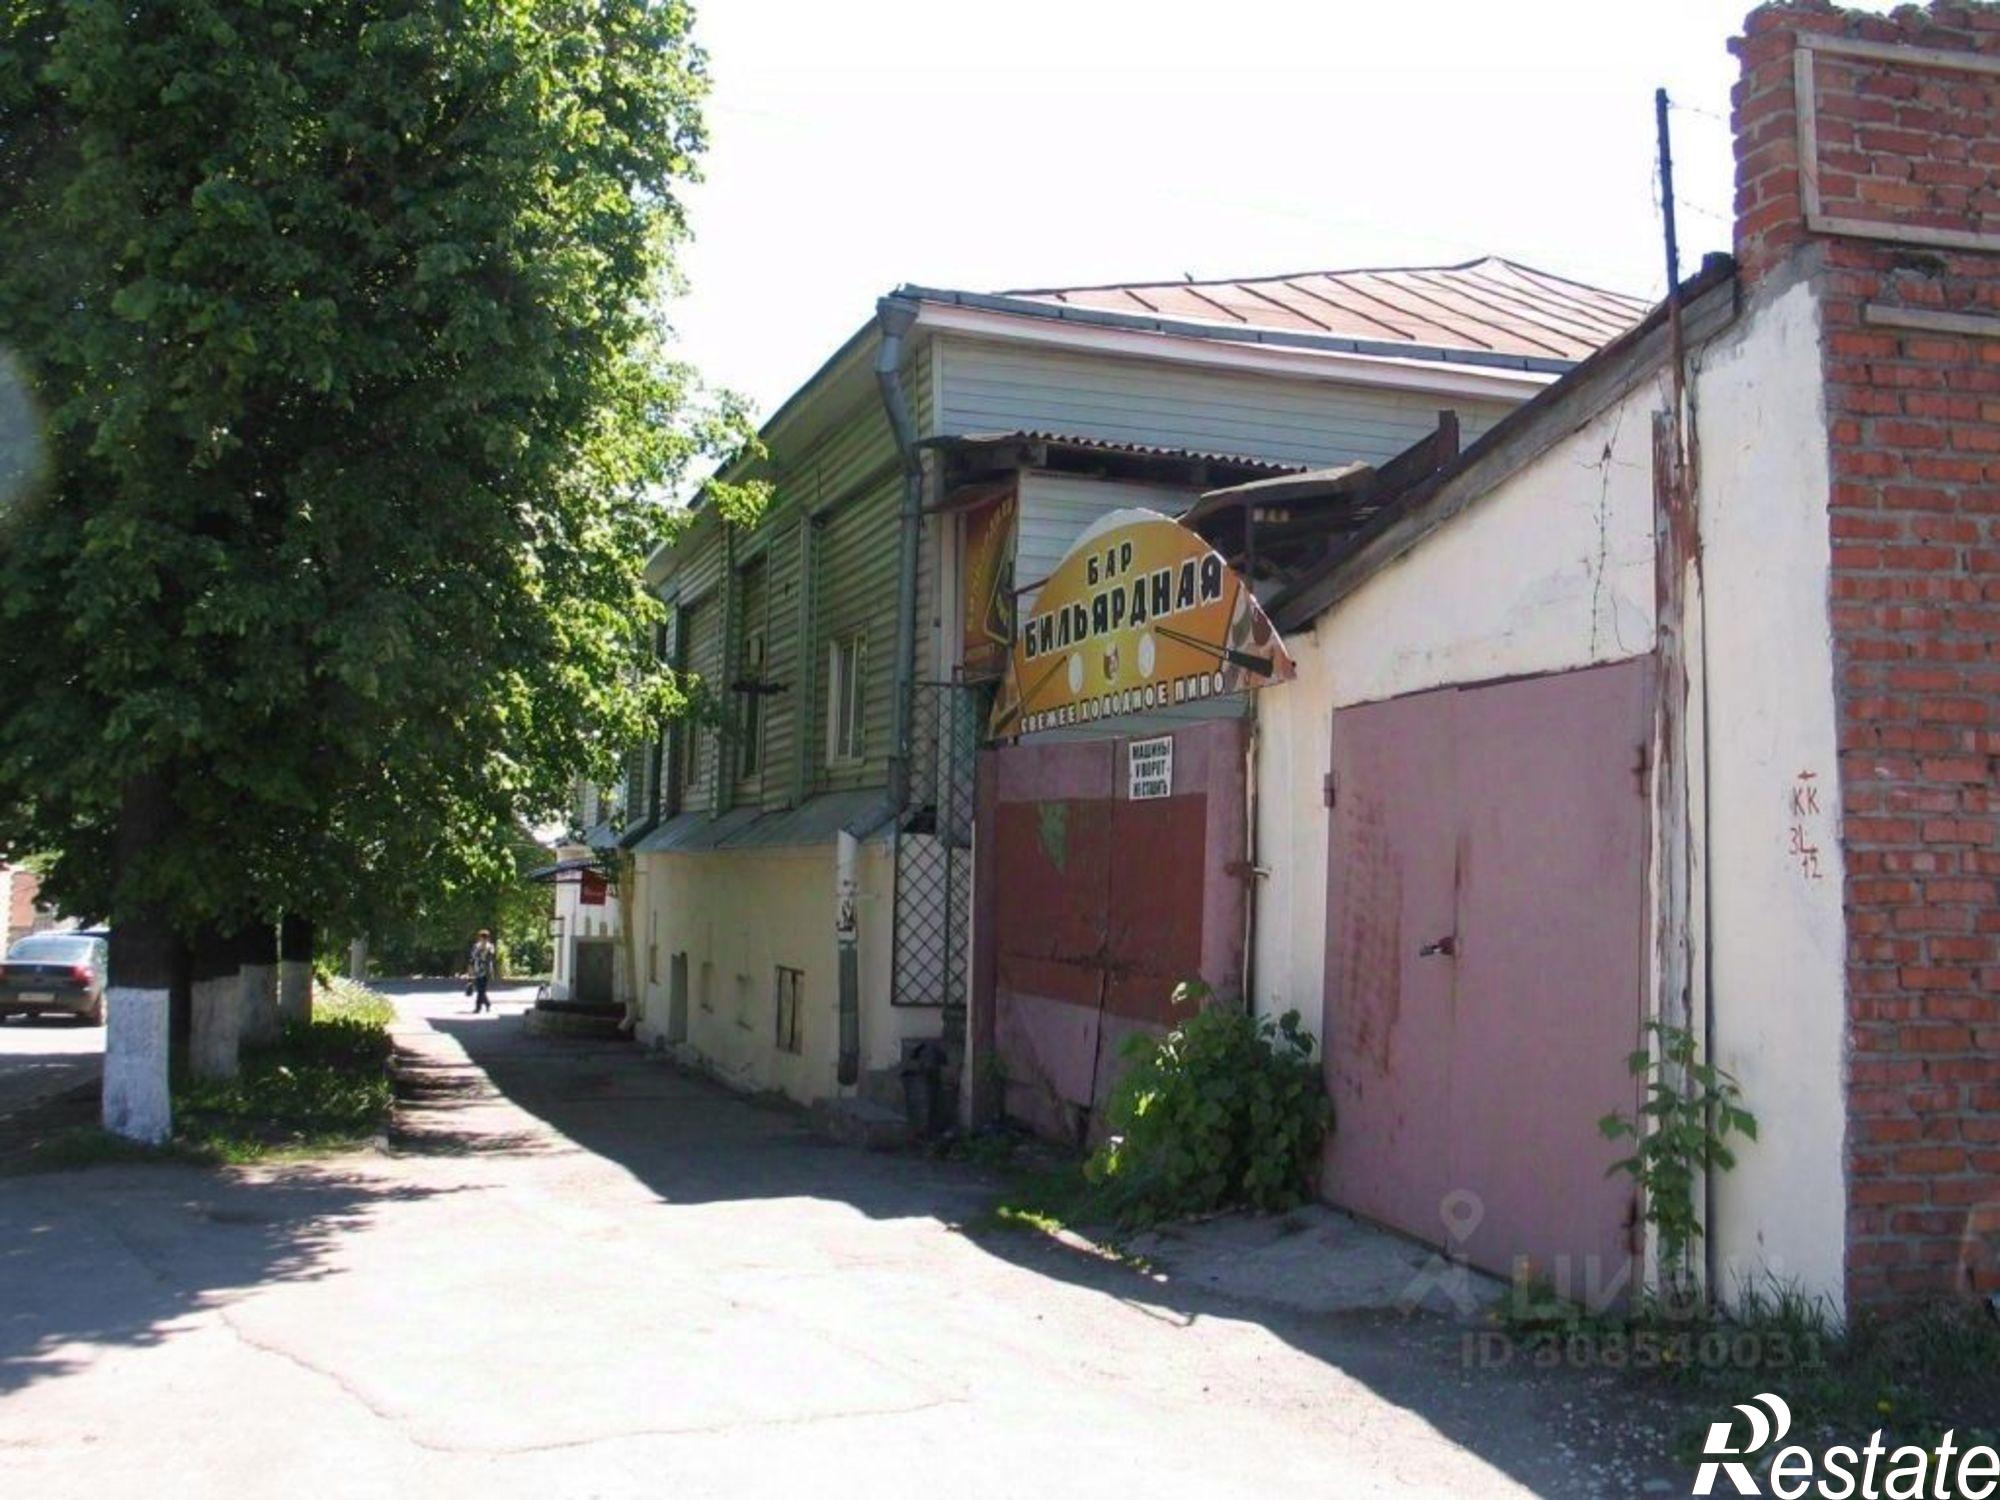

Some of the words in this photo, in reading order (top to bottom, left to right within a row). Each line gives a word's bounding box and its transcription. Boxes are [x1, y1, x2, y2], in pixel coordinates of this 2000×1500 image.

[1086, 541, 1132, 587] БАР
[1023, 551, 1224, 660] БИЛЬЯРДНАЯ
[1173, 669, 1225, 704] ПИВО
[1132, 741, 1170, 760] МАШИНЫ
